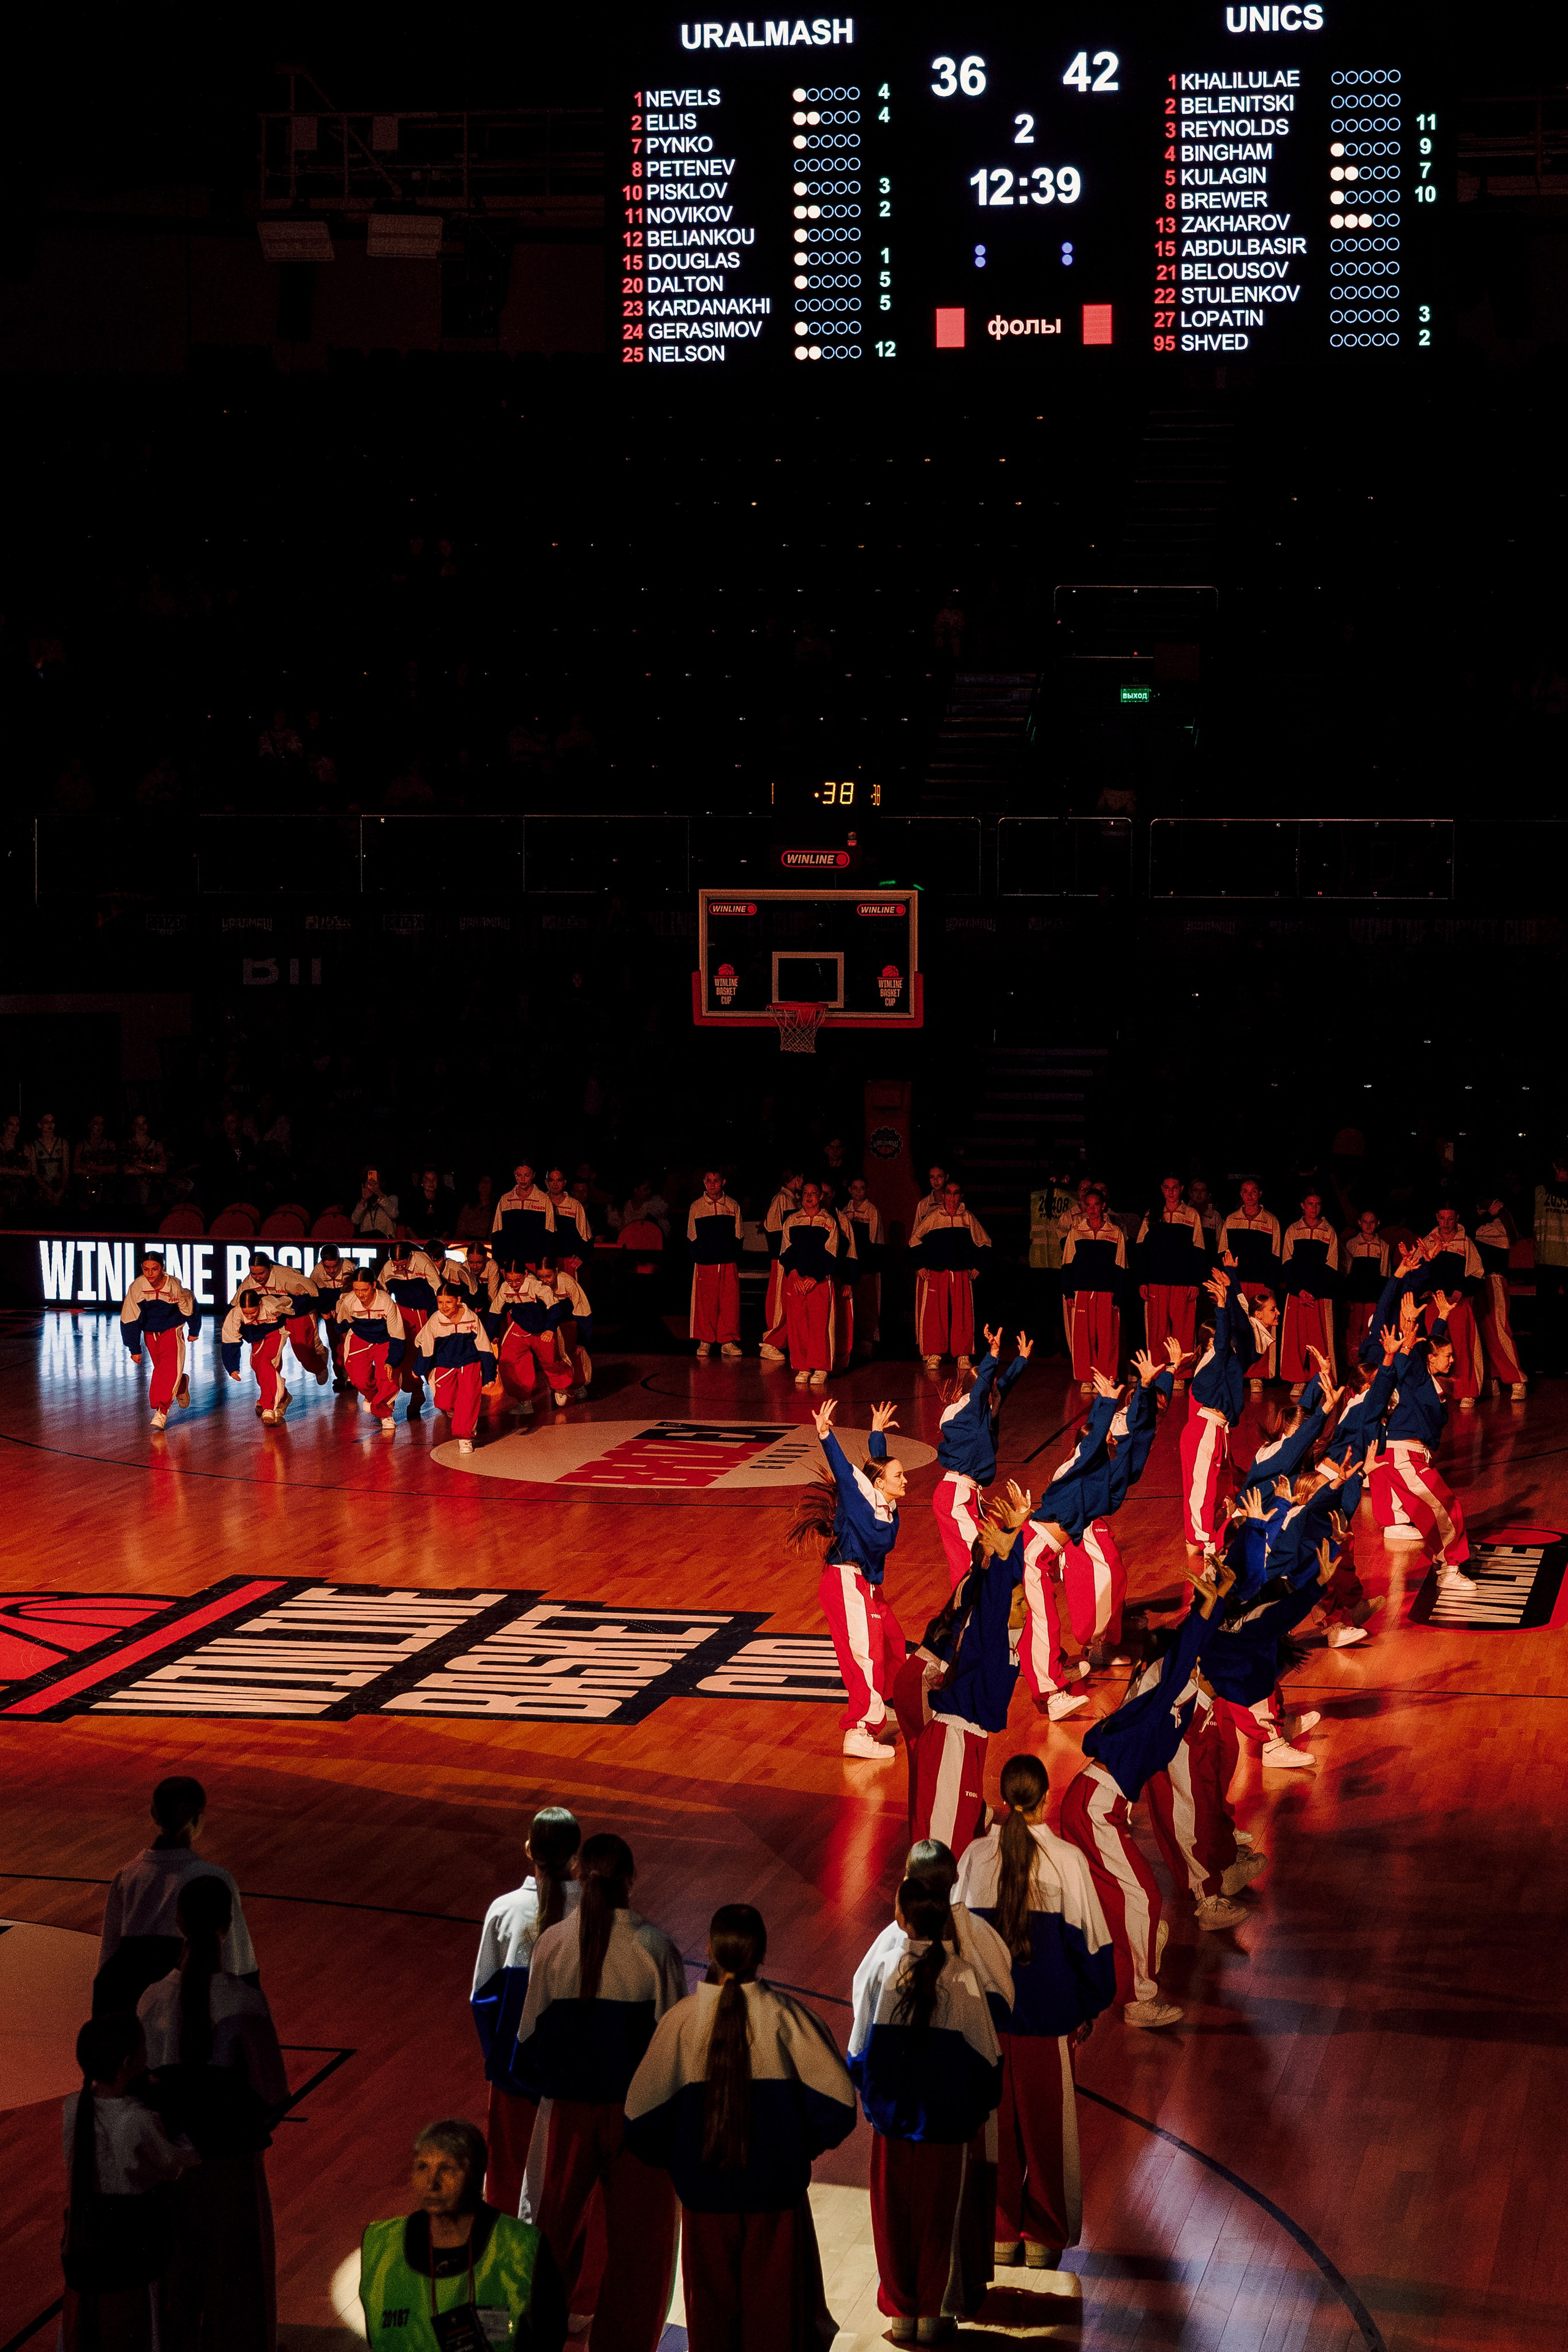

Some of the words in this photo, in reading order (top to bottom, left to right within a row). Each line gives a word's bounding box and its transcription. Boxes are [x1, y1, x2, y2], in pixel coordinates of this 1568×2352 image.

[1226, 4, 1324, 32] UNICS
[681, 18, 853, 49] URALMASH
[932, 55, 986, 97] 36
[1063, 51, 1119, 92] 42
[1169, 74, 1176, 90] 1
[1182, 69, 1300, 90] KHALILULAE
[634, 92, 641, 107] 1
[646, 89, 720, 107] NEVELS
[878, 83, 890, 99] 4
[1165, 98, 1176, 114] 2
[1181, 95, 1294, 114] BELENITSKI
[631, 115, 642, 130] 2
[646, 113, 696, 130] ELLIS
[878, 107, 890, 123] 4
[1014, 113, 1034, 143] 2
[1166, 122, 1175, 138] 3
[1182, 118, 1289, 138] REYNOLDS
[1417, 114, 1435, 130] 11
[631, 138, 642, 154] 7
[646, 136, 713, 154] PYNKO
[1164, 146, 1176, 161] 4
[1182, 143, 1272, 162] BINGHAM
[1420, 138, 1431, 154] 9
[632, 162, 642, 177] 8
[647, 159, 735, 177] PETENEV
[1165, 170, 1175, 186] 5
[1182, 167, 1266, 185] KULAGIN
[1420, 162, 1431, 178] 7
[622, 185, 642, 200] 10
[647, 183, 728, 200] PISKLOV
[880, 178, 890, 194] 3
[970, 167, 1080, 206] 12:39
[1166, 193, 1175, 209] 8
[1182, 191, 1268, 209] BREWER
[1415, 186, 1436, 202] 10
[625, 208, 643, 224] 11
[647, 206, 733, 224] NOVIKOV
[880, 201, 891, 217] 2
[1155, 217, 1175, 233] 13
[1182, 214, 1291, 233] ZAKHAROV
[623, 232, 643, 247] 12
[647, 228, 754, 247] BELIANKOU
[1155, 241, 1175, 257] 15
[1182, 238, 1306, 257] ABDULBASIR
[622, 255, 643, 270] 15
[649, 252, 740, 270] DOUGLAS
[881, 248, 889, 263] 1
[622, 277, 643, 293] 20
[647, 276, 723, 293] DALTON
[880, 271, 891, 287] 5
[1156, 265, 1175, 281] 21
[1182, 262, 1289, 280] BELOUSOV
[623, 301, 643, 316] 23
[648, 298, 770, 316] KARDANAKHI
[880, 295, 891, 311] 5
[1155, 288, 1175, 304] 22
[1182, 285, 1300, 304] STULENKOV
[988, 315, 1061, 340] фолы
[1154, 311, 1175, 328] 27
[1182, 309, 1263, 327] LOPATIN
[1419, 306, 1430, 322] 3
[623, 324, 643, 339] 24
[649, 321, 763, 339] GERASIMOV
[1154, 335, 1175, 351] 95
[1182, 334, 1248, 351] SHVED
[1419, 330, 1430, 345] 2
[622, 347, 643, 363] 25
[649, 345, 725, 362] NELSON
[875, 341, 895, 357] 12
[787, 854, 834, 864] WINLINE
[714, 978, 738, 987] WINLINE
[880, 989, 900, 997] BASKET
[721, 996, 731, 1005] CUP
[885, 998, 895, 1006] CUP
[1038, 1196, 1069, 1213] 2408
[39, 1240, 214, 1304] WINLNE
[554, 1421, 801, 1487] BROZEX
[748, 1443, 817, 1469] GROUP
[90, 1588, 508, 1713] WINLINE
[380, 1605, 734, 1717] BASKET
